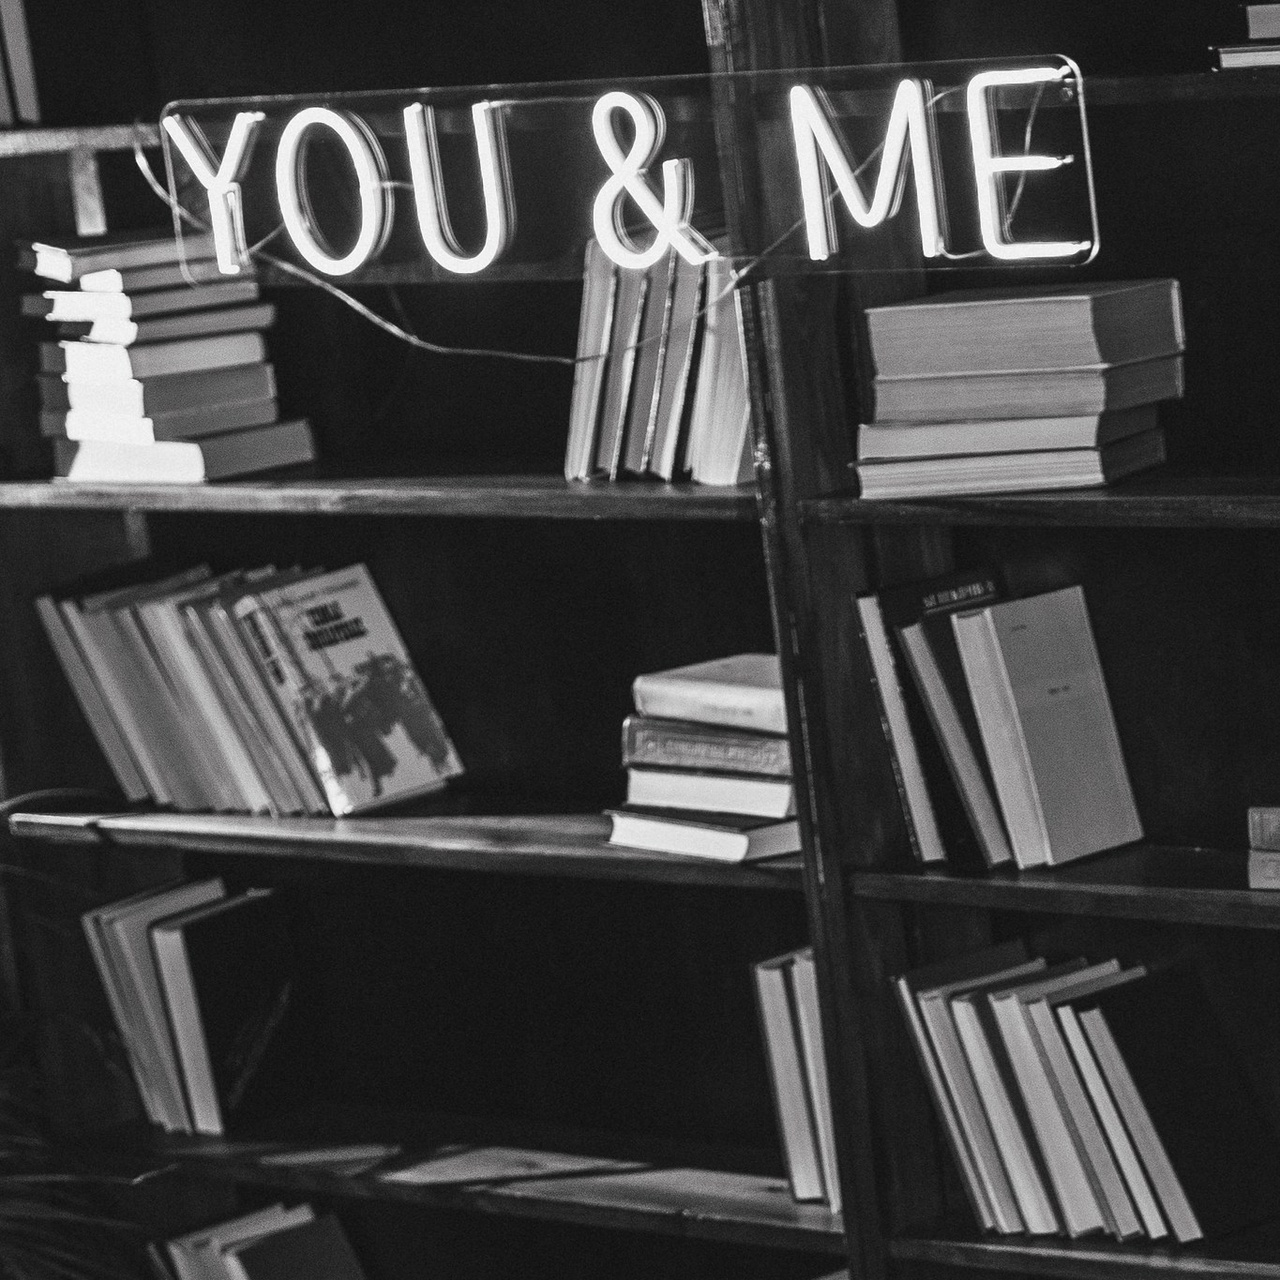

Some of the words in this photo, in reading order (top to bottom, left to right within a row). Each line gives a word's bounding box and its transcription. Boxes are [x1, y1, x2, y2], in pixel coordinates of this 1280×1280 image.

[163, 104, 513, 274] YOU
[592, 91, 719, 269] &
[790, 64, 1091, 261] ME
